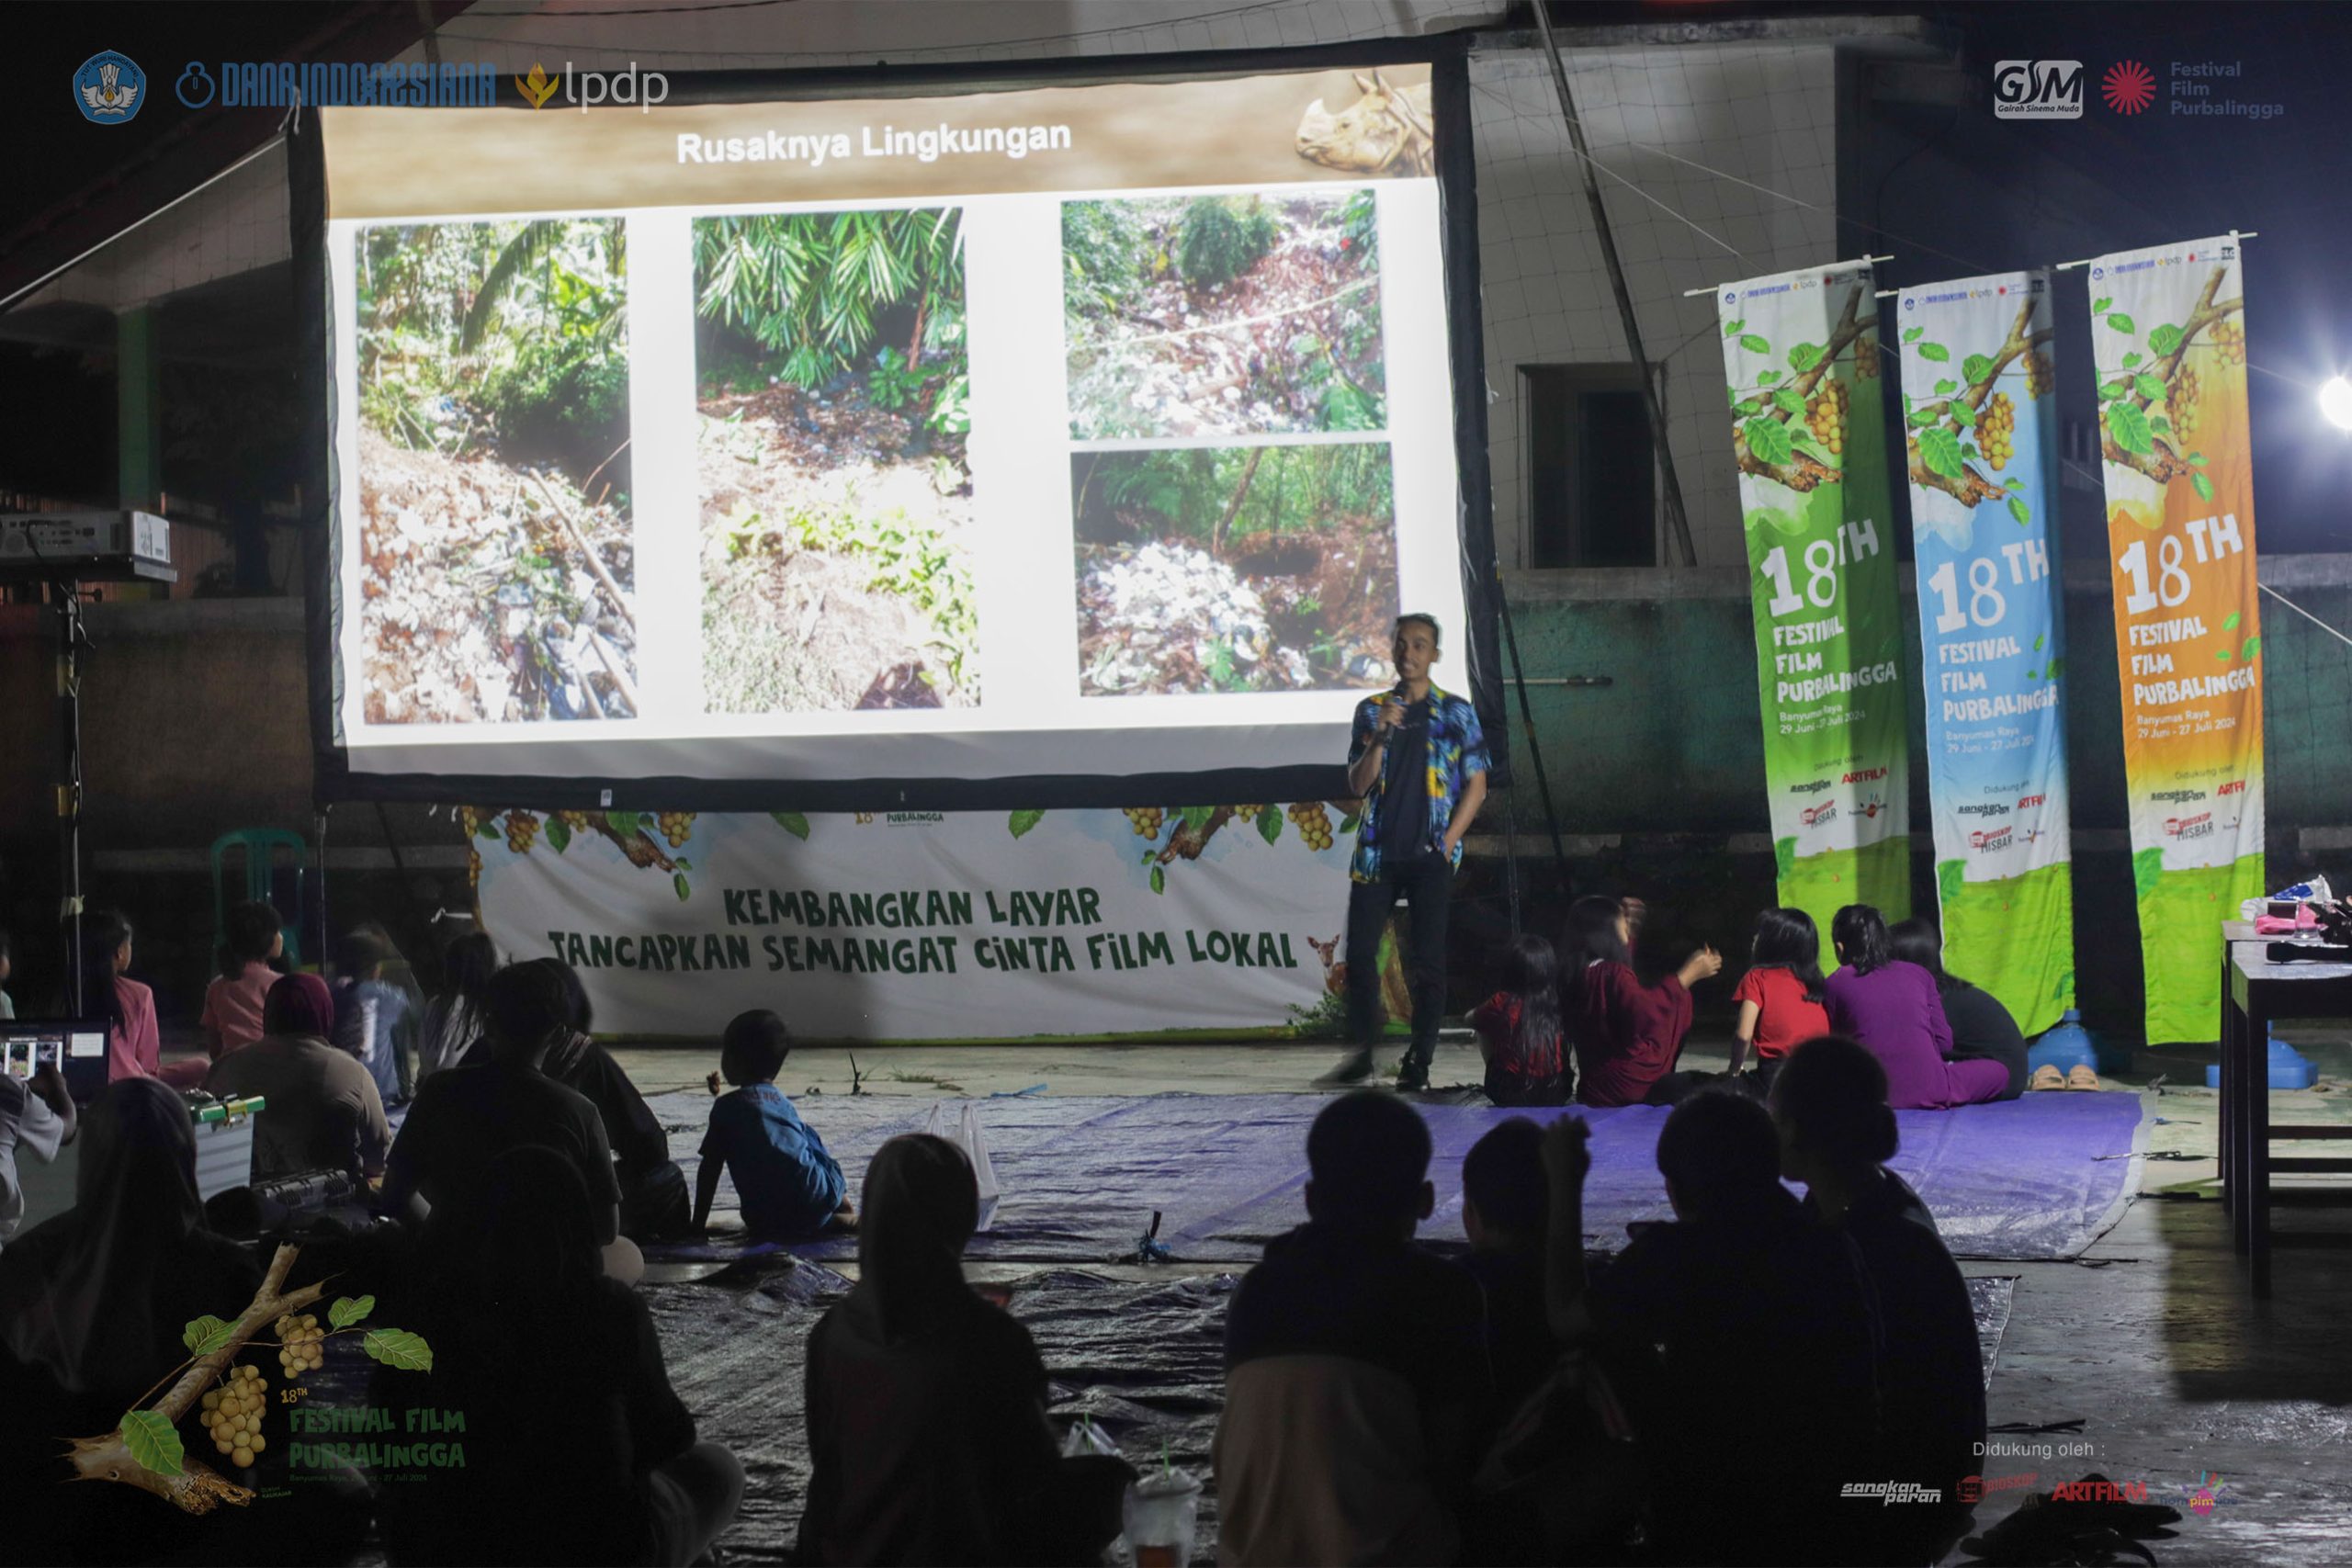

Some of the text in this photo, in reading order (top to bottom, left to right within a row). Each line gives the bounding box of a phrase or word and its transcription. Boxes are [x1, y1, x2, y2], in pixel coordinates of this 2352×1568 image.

[677, 124, 1071, 166] Rusaknya Lingkungan
[1773, 616, 1844, 647] FESTIVAL
[2129, 616, 2208, 647] FESTIVAL
[1775, 652, 1823, 674] FILM
[1939, 636, 2020, 664] FESTIVAL
[2132, 654, 2174, 675] FILM
[1940, 672, 1987, 693] FILM
[2133, 666, 2256, 705] PURBALINGGA
[1781, 724, 1792, 735] 29
[1794, 723, 1815, 733] Juni
[724, 887, 1102, 927] KEMBANGKAN LAYAR
[548, 931, 750, 971] TANCAPKAN
[763, 935, 956, 974] SEMANGAT
[1186, 930, 1297, 968] LOKAL
